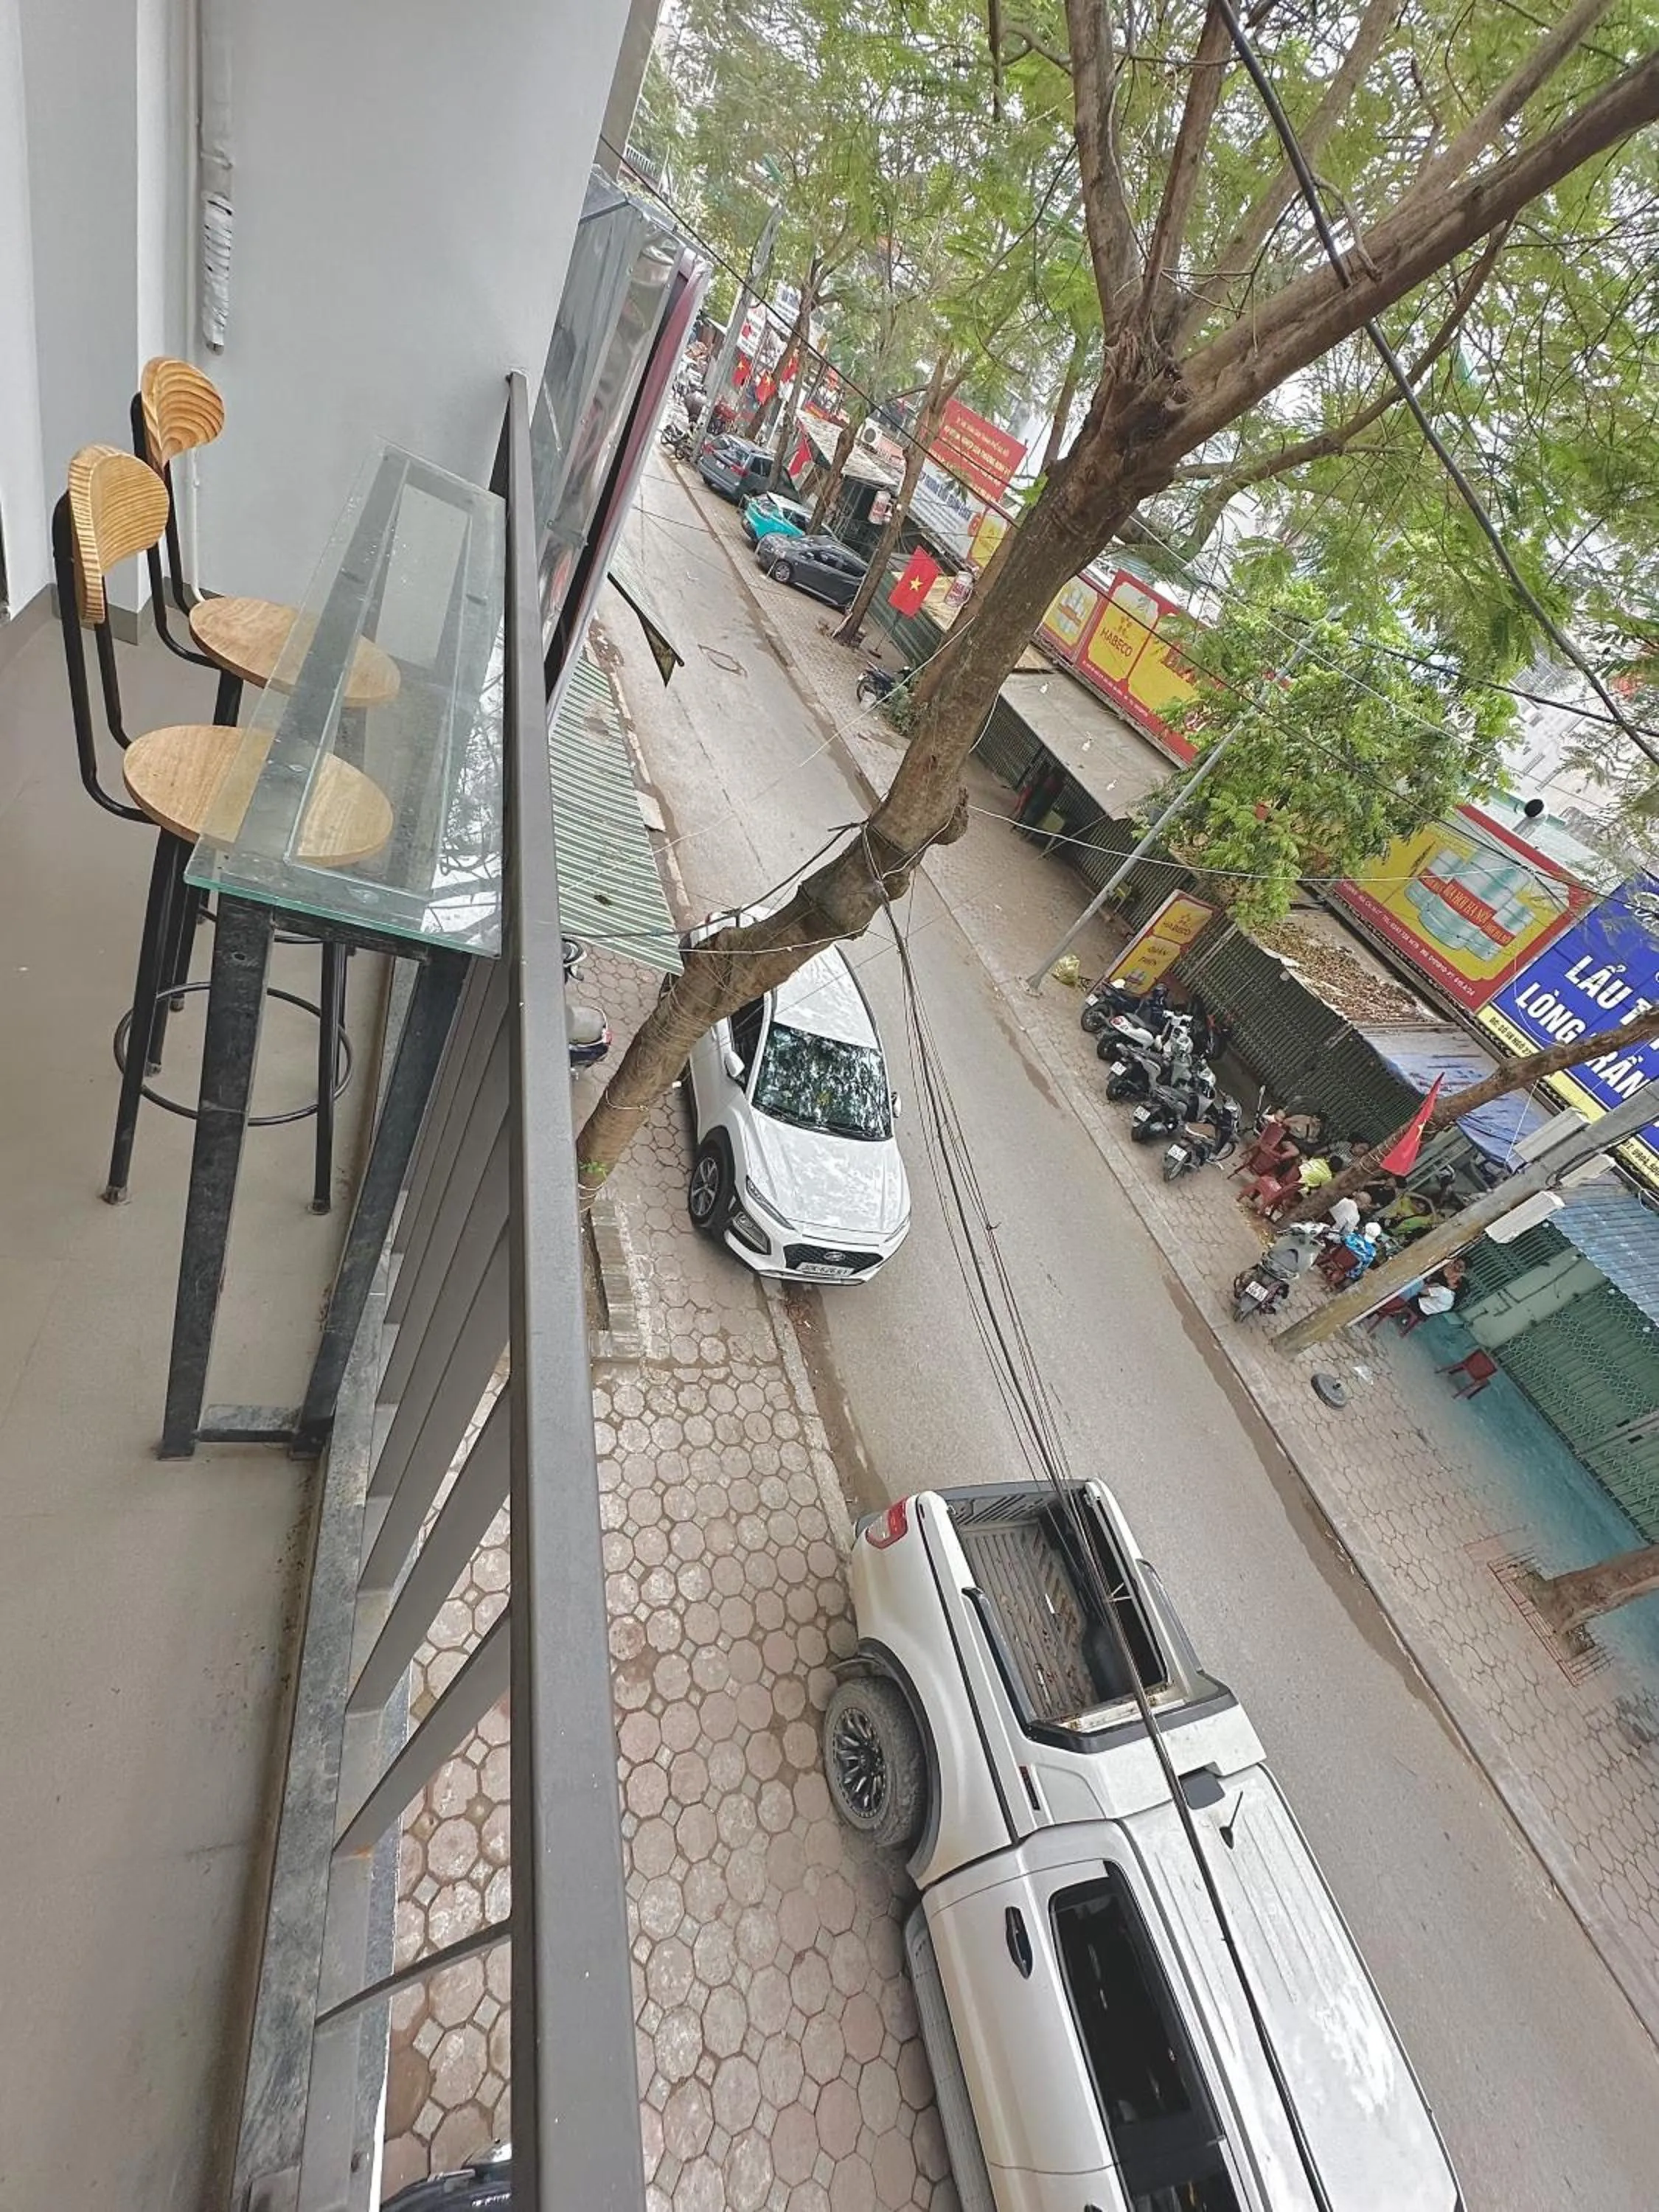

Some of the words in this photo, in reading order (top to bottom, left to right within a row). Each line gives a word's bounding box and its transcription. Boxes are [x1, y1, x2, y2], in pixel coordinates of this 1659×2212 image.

[1099, 627, 1133, 658] HABECO
[1564, 955, 1634, 1009] LẨU
[1514, 981, 1586, 1044] LÒNG
[1583, 1034, 1652, 1099] RẦN
